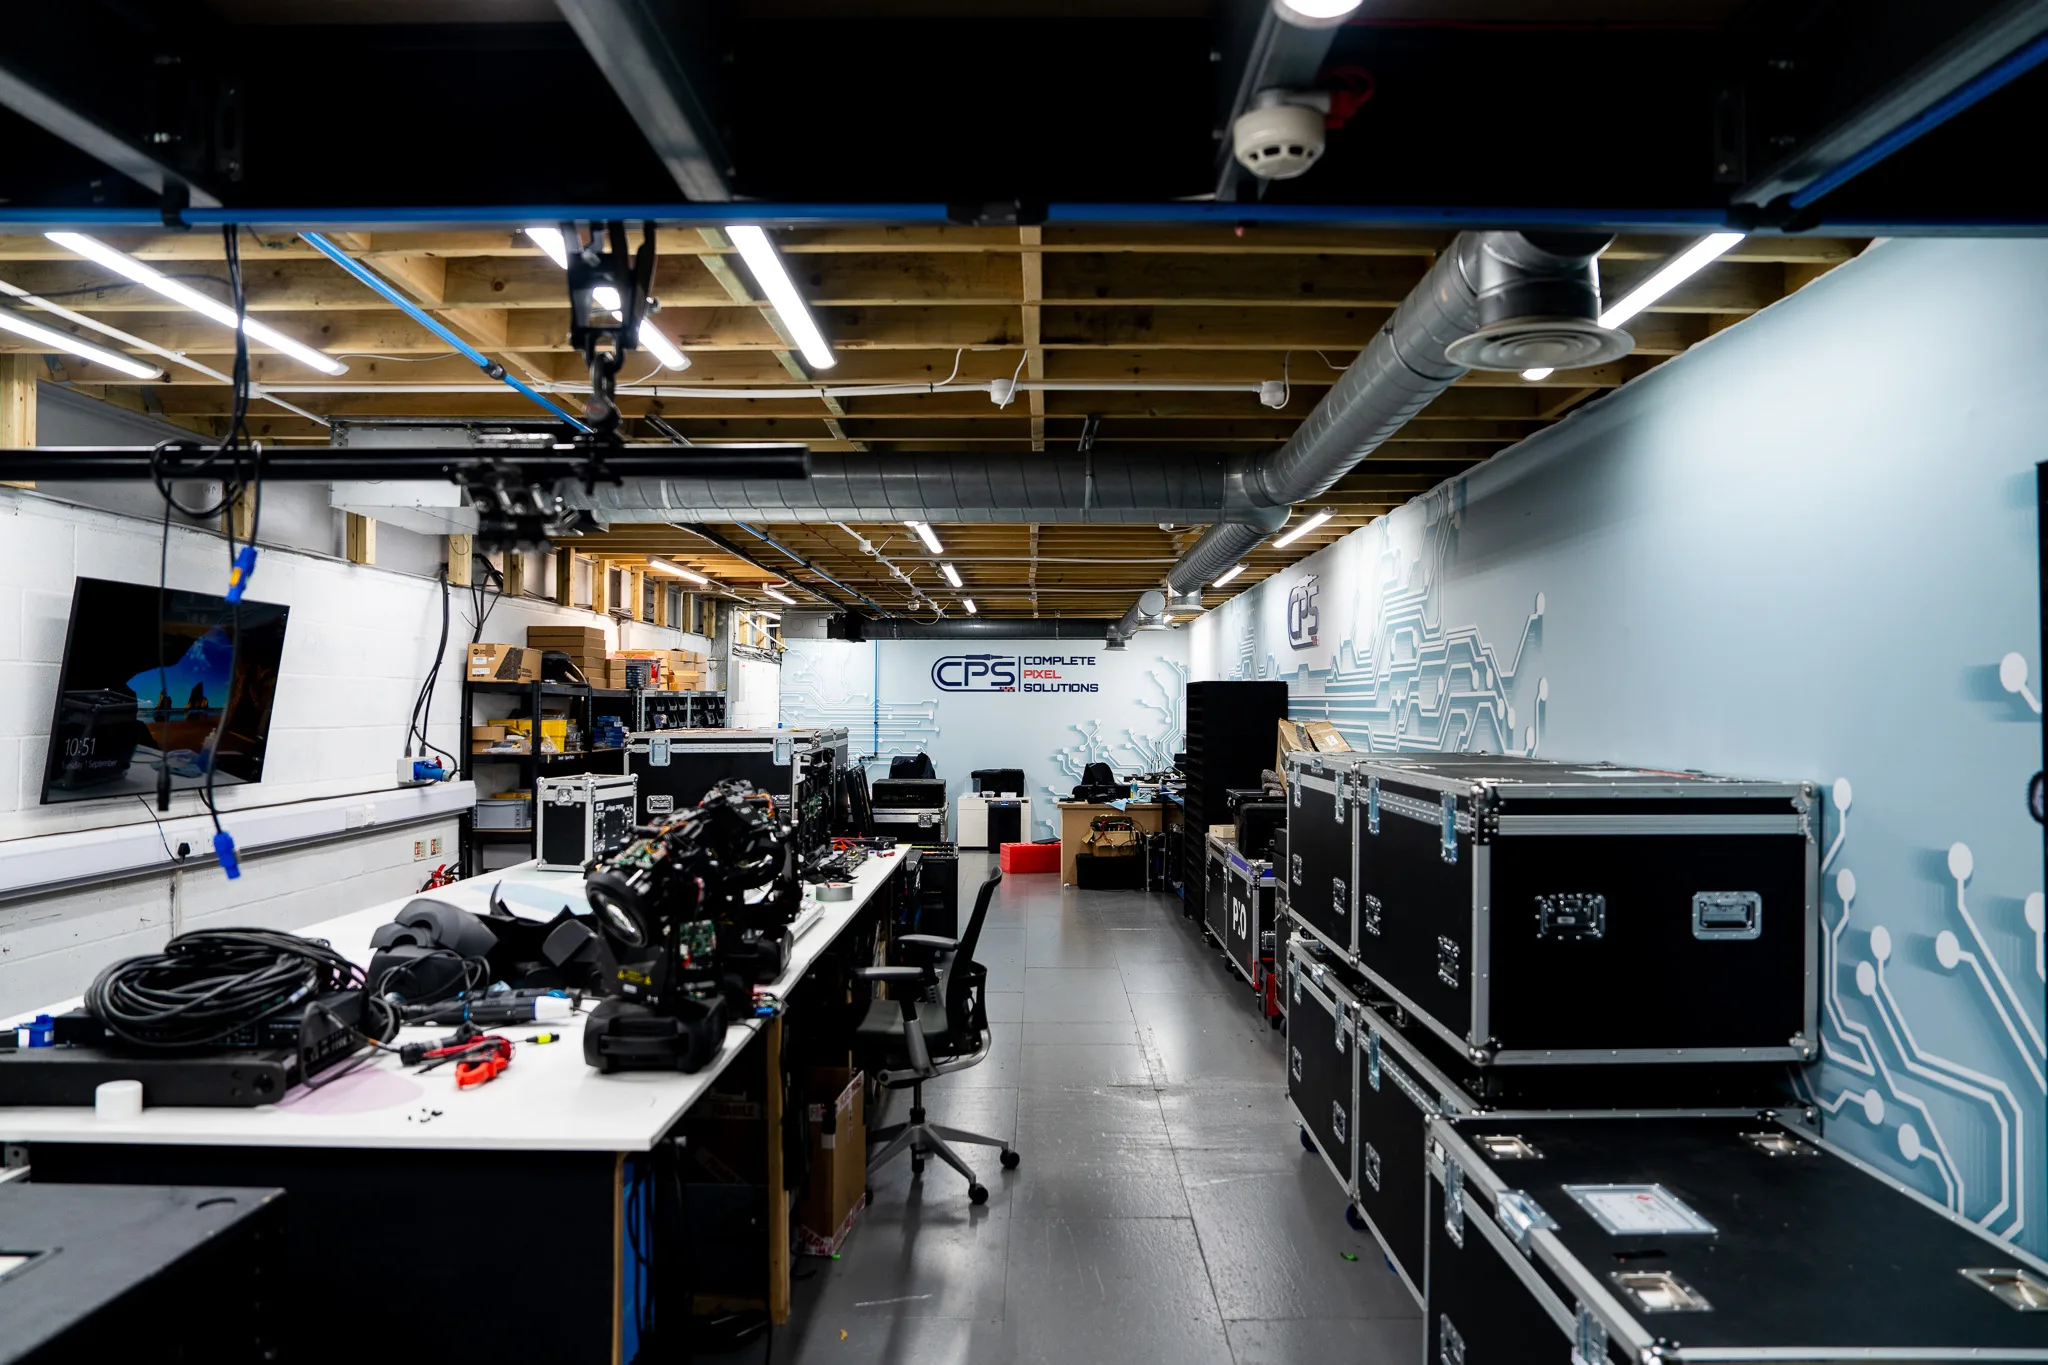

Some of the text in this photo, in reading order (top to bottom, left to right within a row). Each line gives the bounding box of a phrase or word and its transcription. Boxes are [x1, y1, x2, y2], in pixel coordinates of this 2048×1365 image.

[1289, 585, 1319, 640] CPS
[1023, 656, 1097, 666] COMPLETE
[936, 661, 1016, 687] CPS
[1023, 669, 1062, 679] PIXEL
[1023, 683, 1099, 693] SOLUTIONS
[65, 737, 96, 757] 10:51
